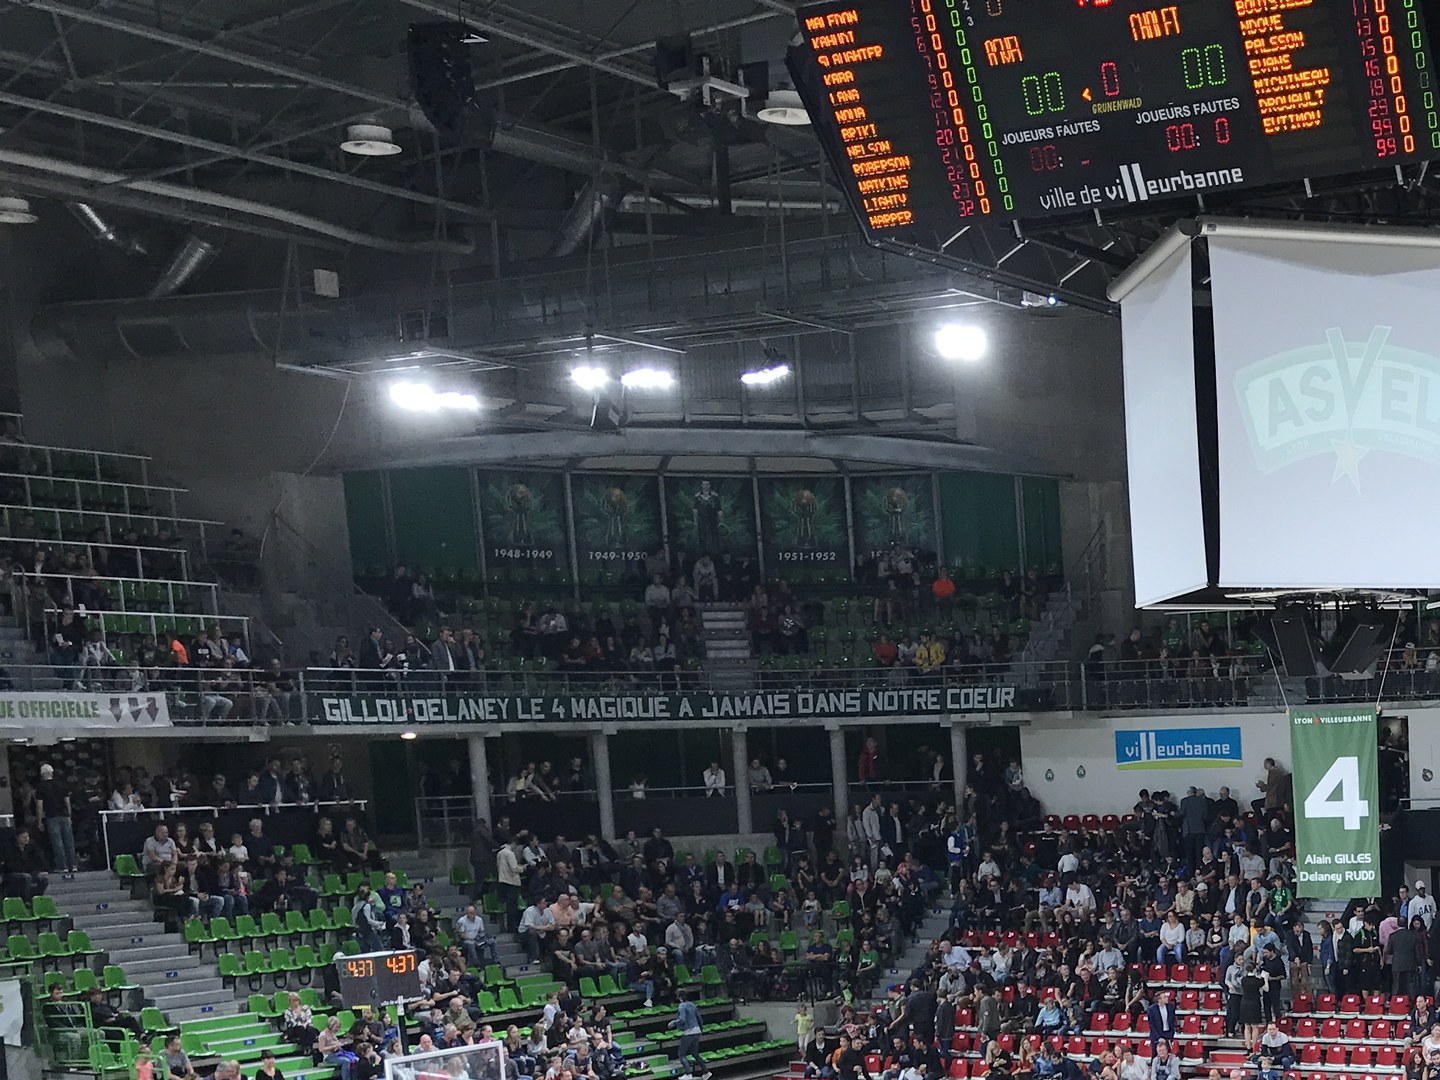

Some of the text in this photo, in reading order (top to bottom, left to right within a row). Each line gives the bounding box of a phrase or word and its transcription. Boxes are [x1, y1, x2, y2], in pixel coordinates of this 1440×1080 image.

[967, 16, 974, 26] 3
[1357, 18, 1371, 36] 13
[1361, 38, 1375, 56] 15
[1181, 43, 1227, 89] 00
[823, 71, 854, 87] KARA
[1101, 60, 1120, 97] 0
[1021, 71, 1065, 116] 00
[1092, 97, 1142, 115] GRUNENWALD
[1136, 98, 1240, 125] JOUEURS FAUTES
[936, 129, 954, 146] 20
[1002, 119, 1100, 146] JOUEURS FAUTES
[1040, 163, 1243, 210] ville de villeurbanne
[959, 200, 974, 217] 32
[493, 548, 553, 560] 1948-1949
[18, 700, 100, 720] OFFICIELLE
[323, 686, 1016, 722] GILLOU DELANEY LE 4 MAGIQUE A JAMAIS DANS NOTRE COEUR
[1319, 714, 1372, 724] VILLEURBANNE
[1125, 731, 1231, 761] villeurbanne
[1303, 755, 1369, 831] 4
[1304, 853, 1372, 865] Alain GILLES
[1300, 870, 1375, 884] Delaney RUDD
[386, 954, 415, 974] 4:37
